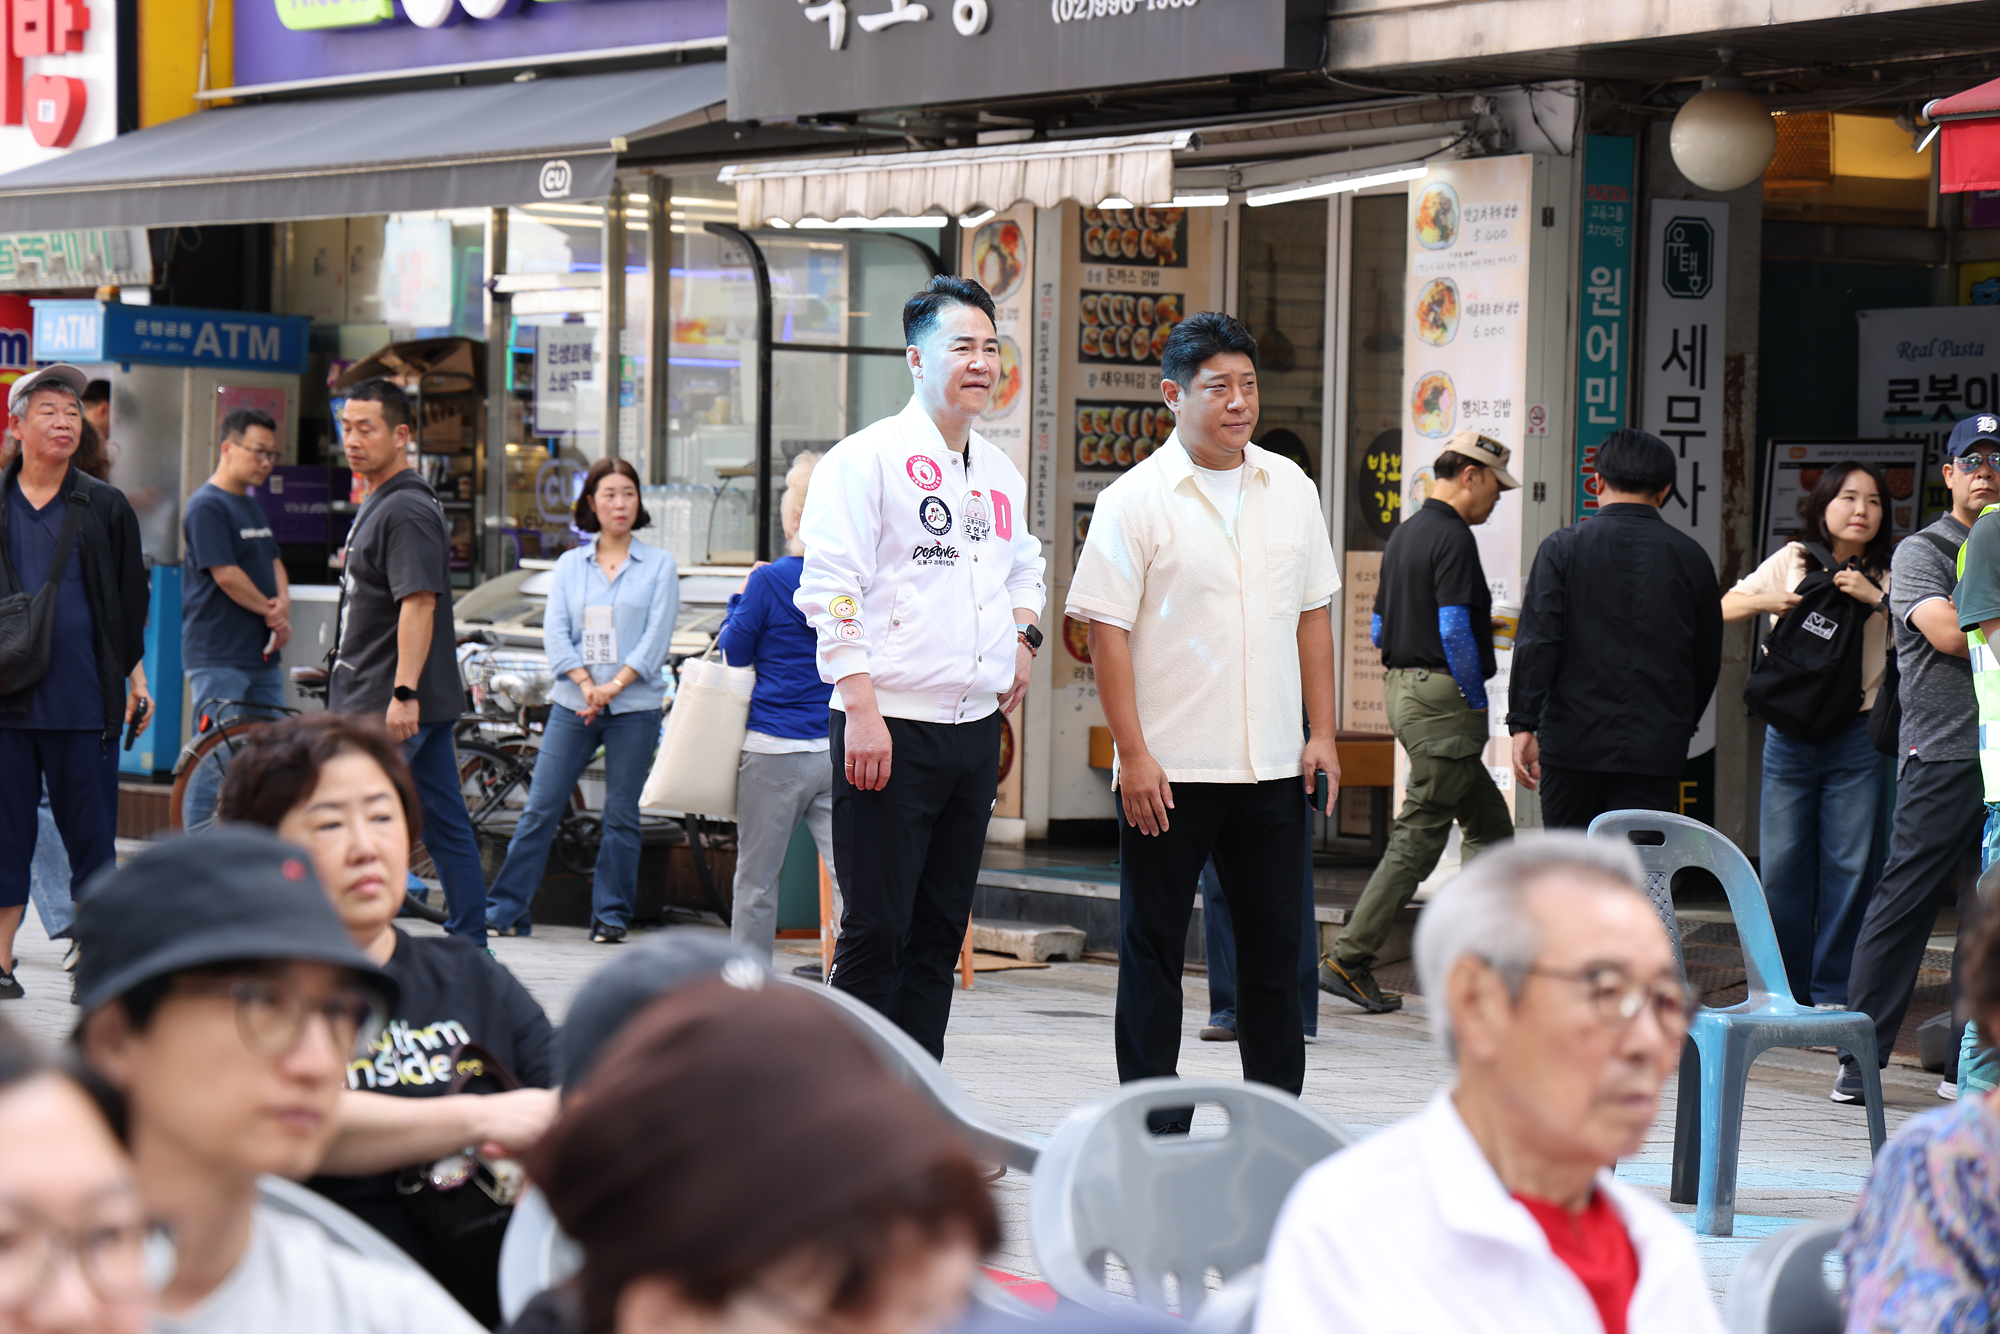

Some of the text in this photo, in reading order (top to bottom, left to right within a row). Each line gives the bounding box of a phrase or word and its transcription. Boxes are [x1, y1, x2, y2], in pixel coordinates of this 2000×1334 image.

[1586, 185, 1630, 202] PAGODA
[1591, 205, 1624, 222] 교육그룹
[1587, 222, 1627, 248] 차이랑
[1105, 267, 1138, 285] 돈까스
[1141, 269, 1161, 287] 김밥
[54, 314, 96, 350] ATM
[192, 321, 281, 362] ATM
[1586, 266, 1622, 424] 원어민
[1897, 338, 1985, 362] Real Pasta
[1101, 370, 1145, 389] 새우튀김
[1462, 398, 1511, 418] 햄치즈 김밥
[1660, 323, 1707, 527] 세무사
[544, 474, 574, 506] CU
[912, 544, 956, 560] DOBONG
